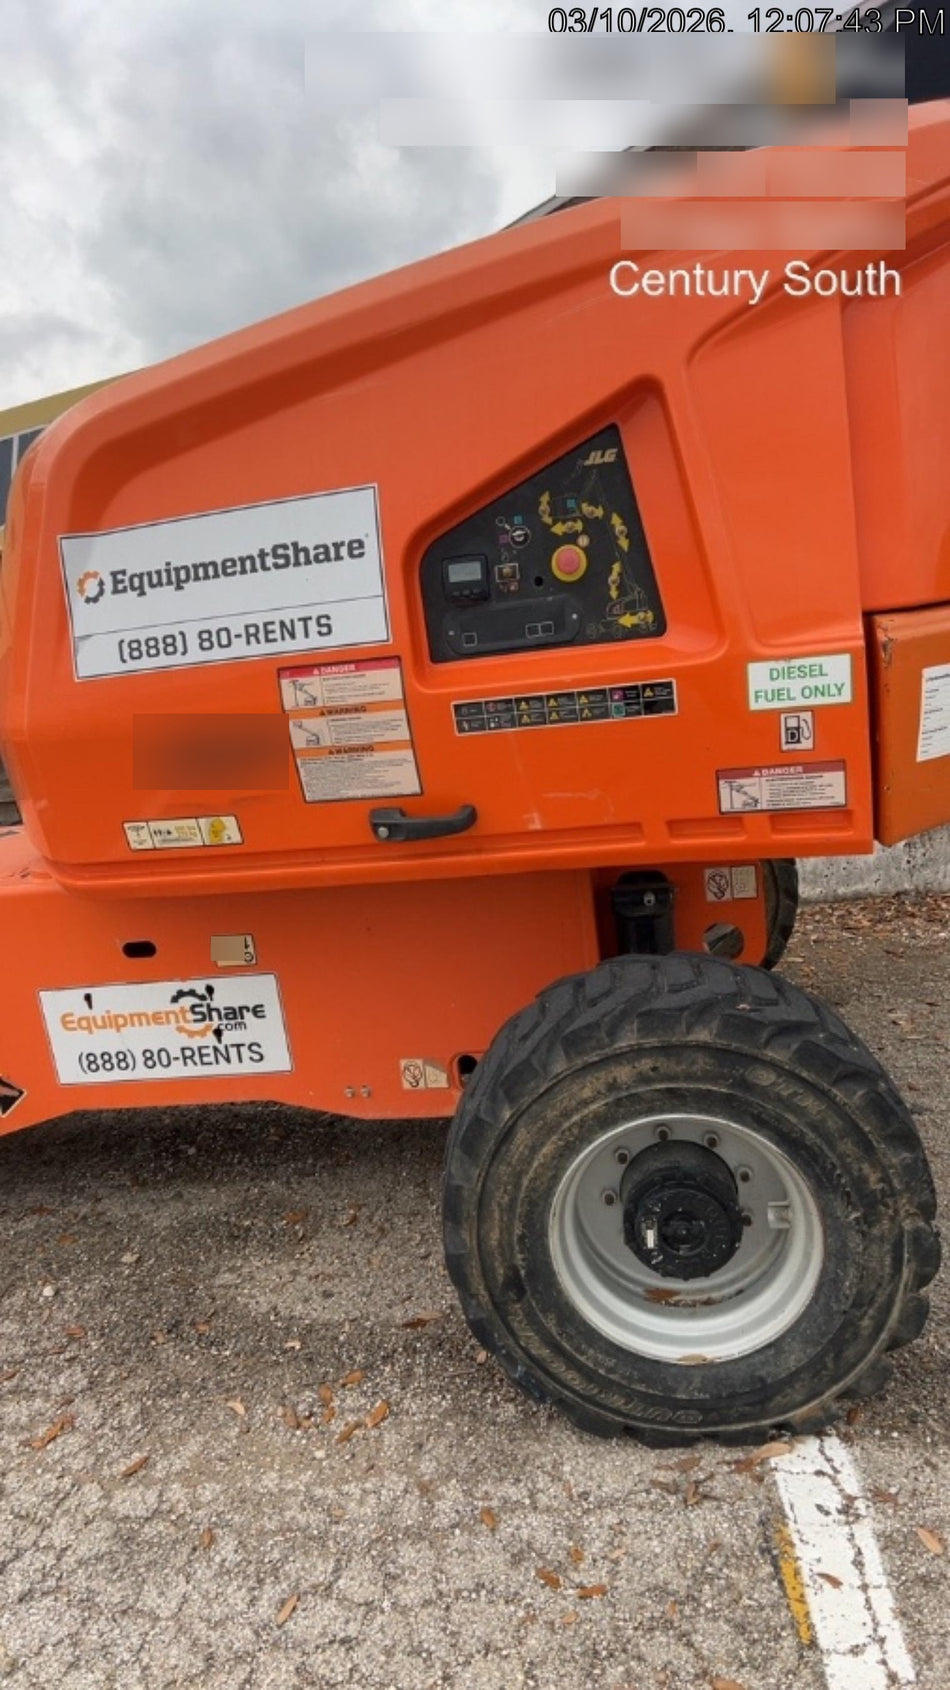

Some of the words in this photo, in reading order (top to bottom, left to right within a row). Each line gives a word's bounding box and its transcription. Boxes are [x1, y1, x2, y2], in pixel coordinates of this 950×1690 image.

[584, 448, 618, 466] JLG
[110, 537, 365, 597] EquipmentShare
[118, 631, 188, 663] (888)
[198, 614, 333, 651] 80-RENTS
[769, 664, 828, 681] DIESEL
[754, 687, 796, 703] FUEL
[801, 682, 845, 699] ONLY
[787, 729, 799, 743] D
[761, 766, 803, 776] DANGER
[60, 1003, 266, 1034] EquipmentShare
[78, 1048, 136, 1074] (888)
[142, 1042, 264, 1069] 80-RENTS
